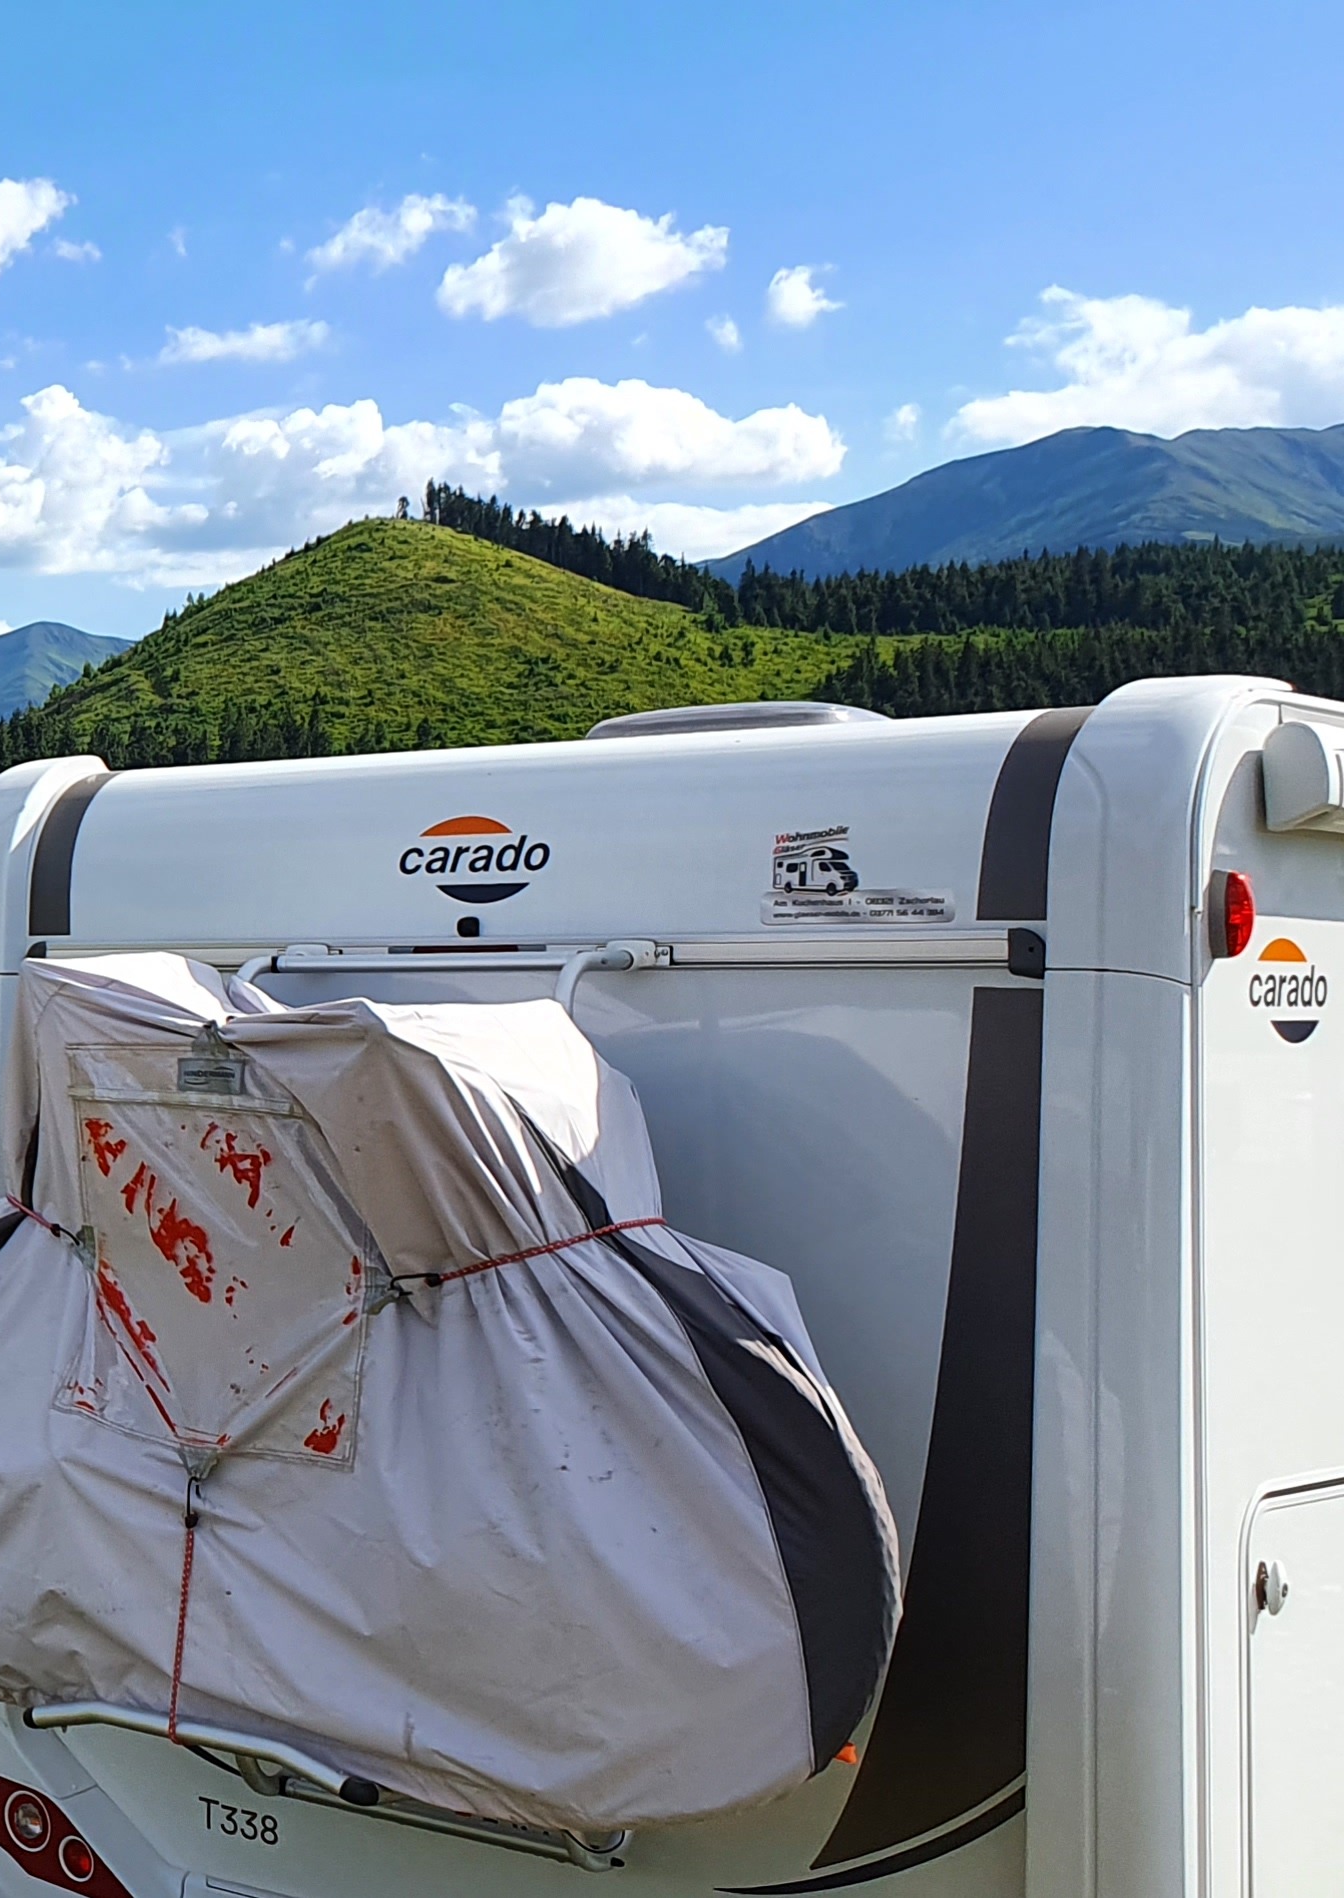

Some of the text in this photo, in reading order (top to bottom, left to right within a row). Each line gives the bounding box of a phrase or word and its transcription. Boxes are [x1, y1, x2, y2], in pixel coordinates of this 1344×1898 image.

[775, 825, 850, 844] Wohnmobile
[399, 834, 551, 875] carado
[773, 899, 788, 907] Am
[911, 908, 924, 916] 44
[1249, 964, 1328, 1008] carado
[198, 1795, 279, 1846] T338
